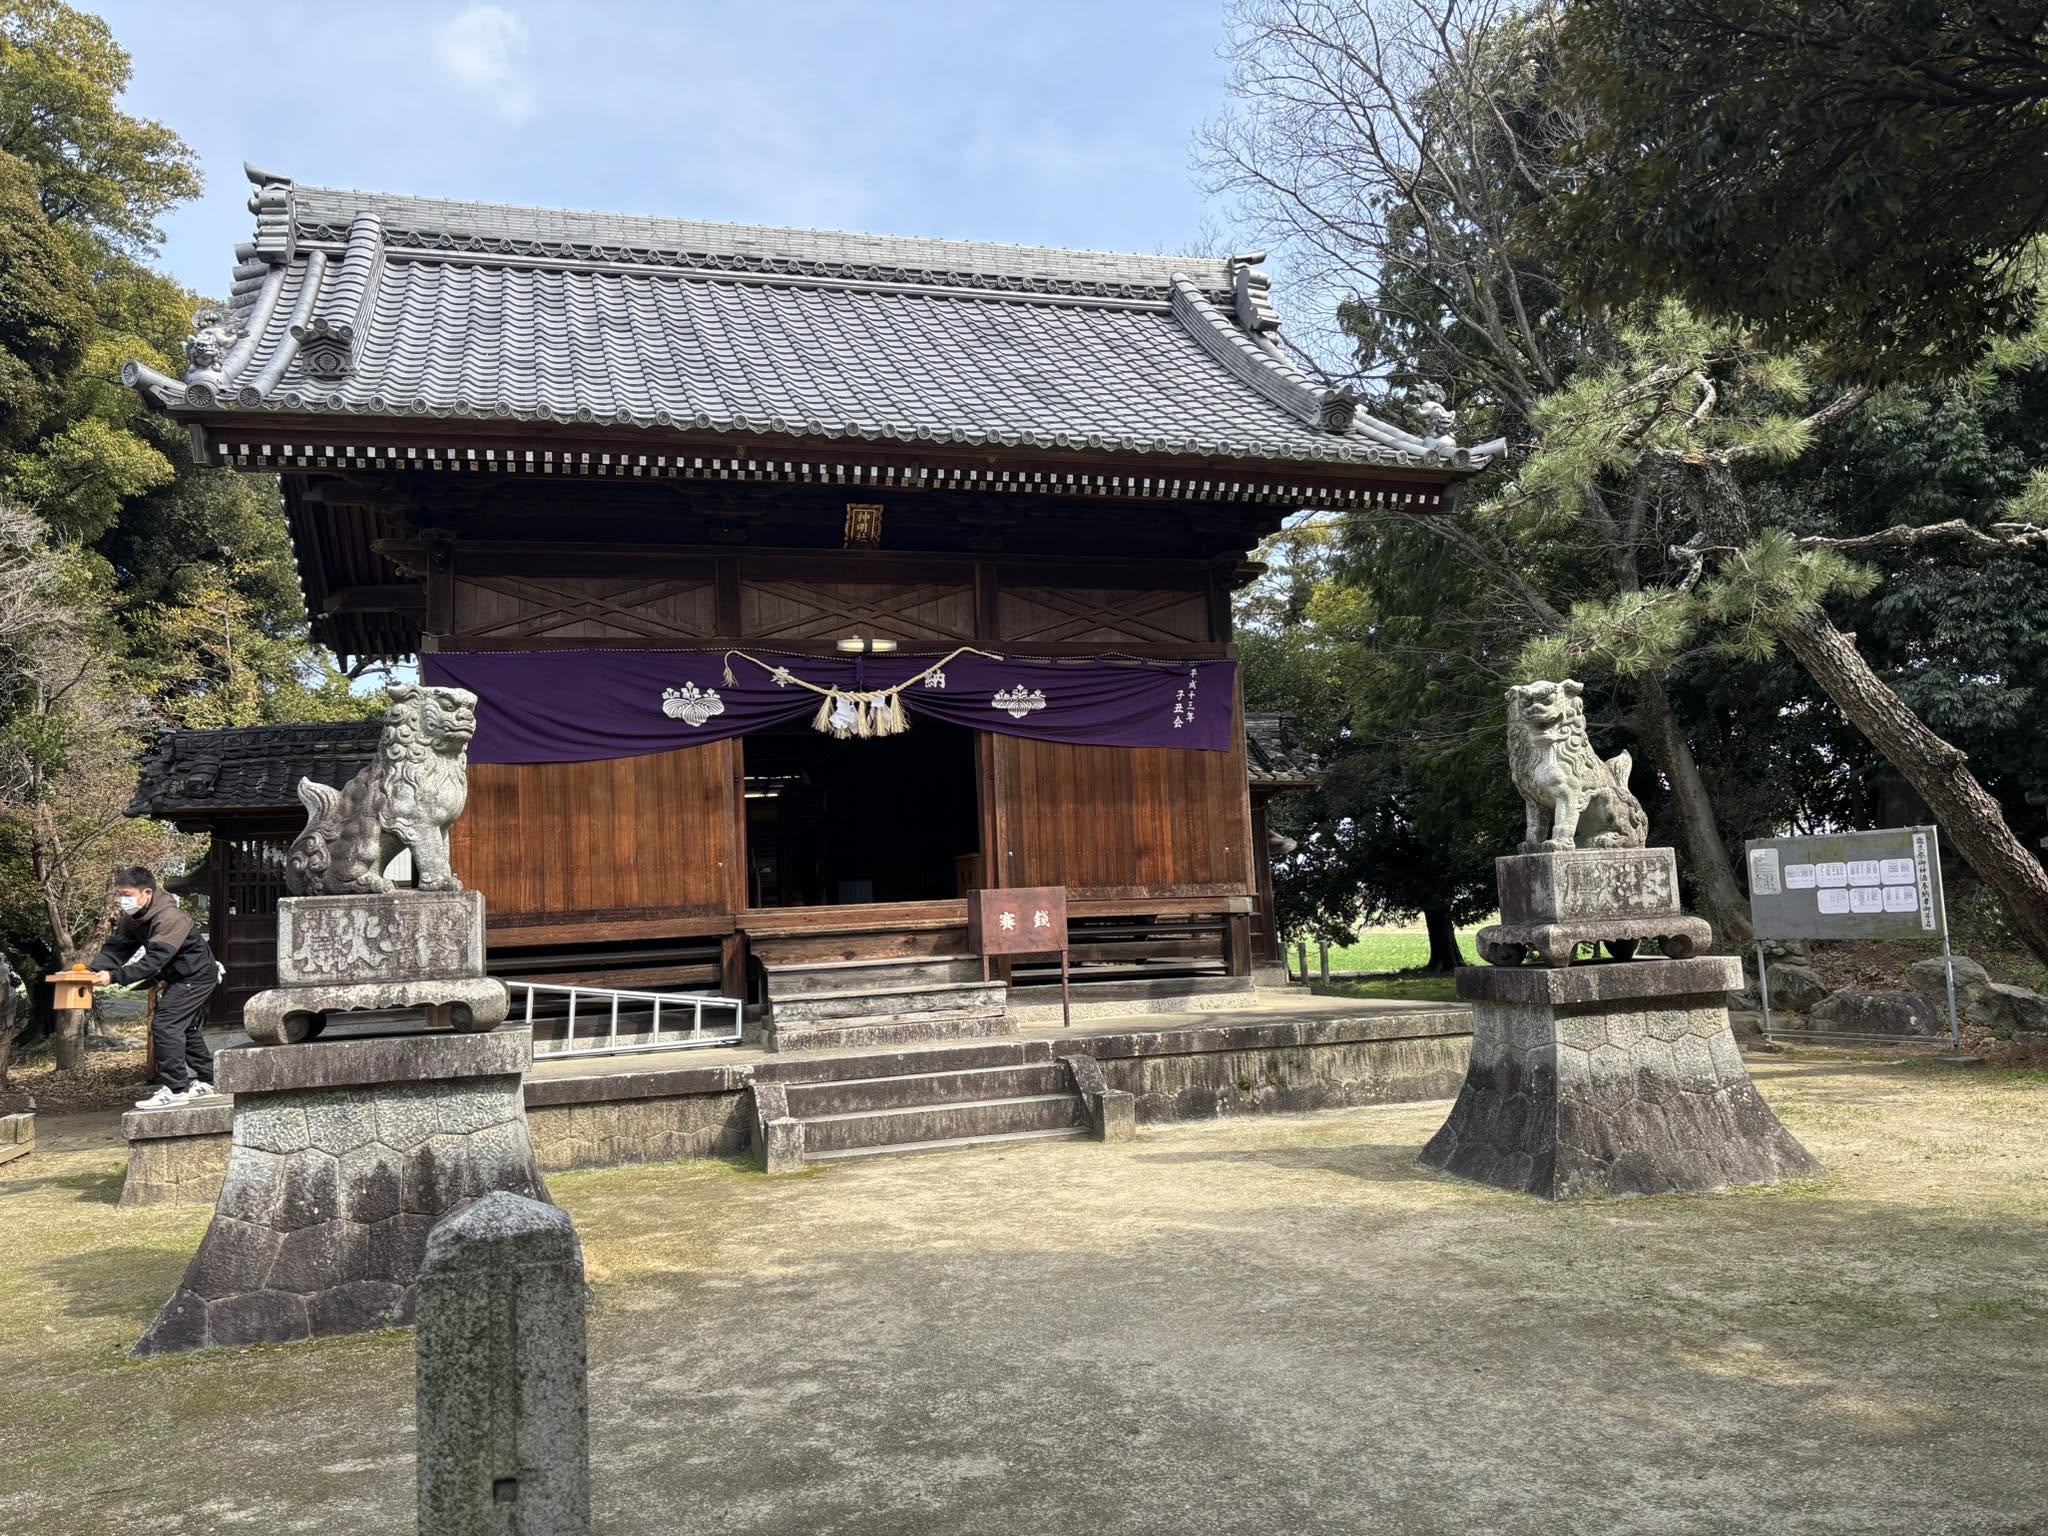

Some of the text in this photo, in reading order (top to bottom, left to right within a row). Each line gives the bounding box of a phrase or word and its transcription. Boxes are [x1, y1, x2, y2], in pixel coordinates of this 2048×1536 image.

[1173, 689, 1185, 728] 子丑会
[1186, 668, 1198, 723] 平成十三年
